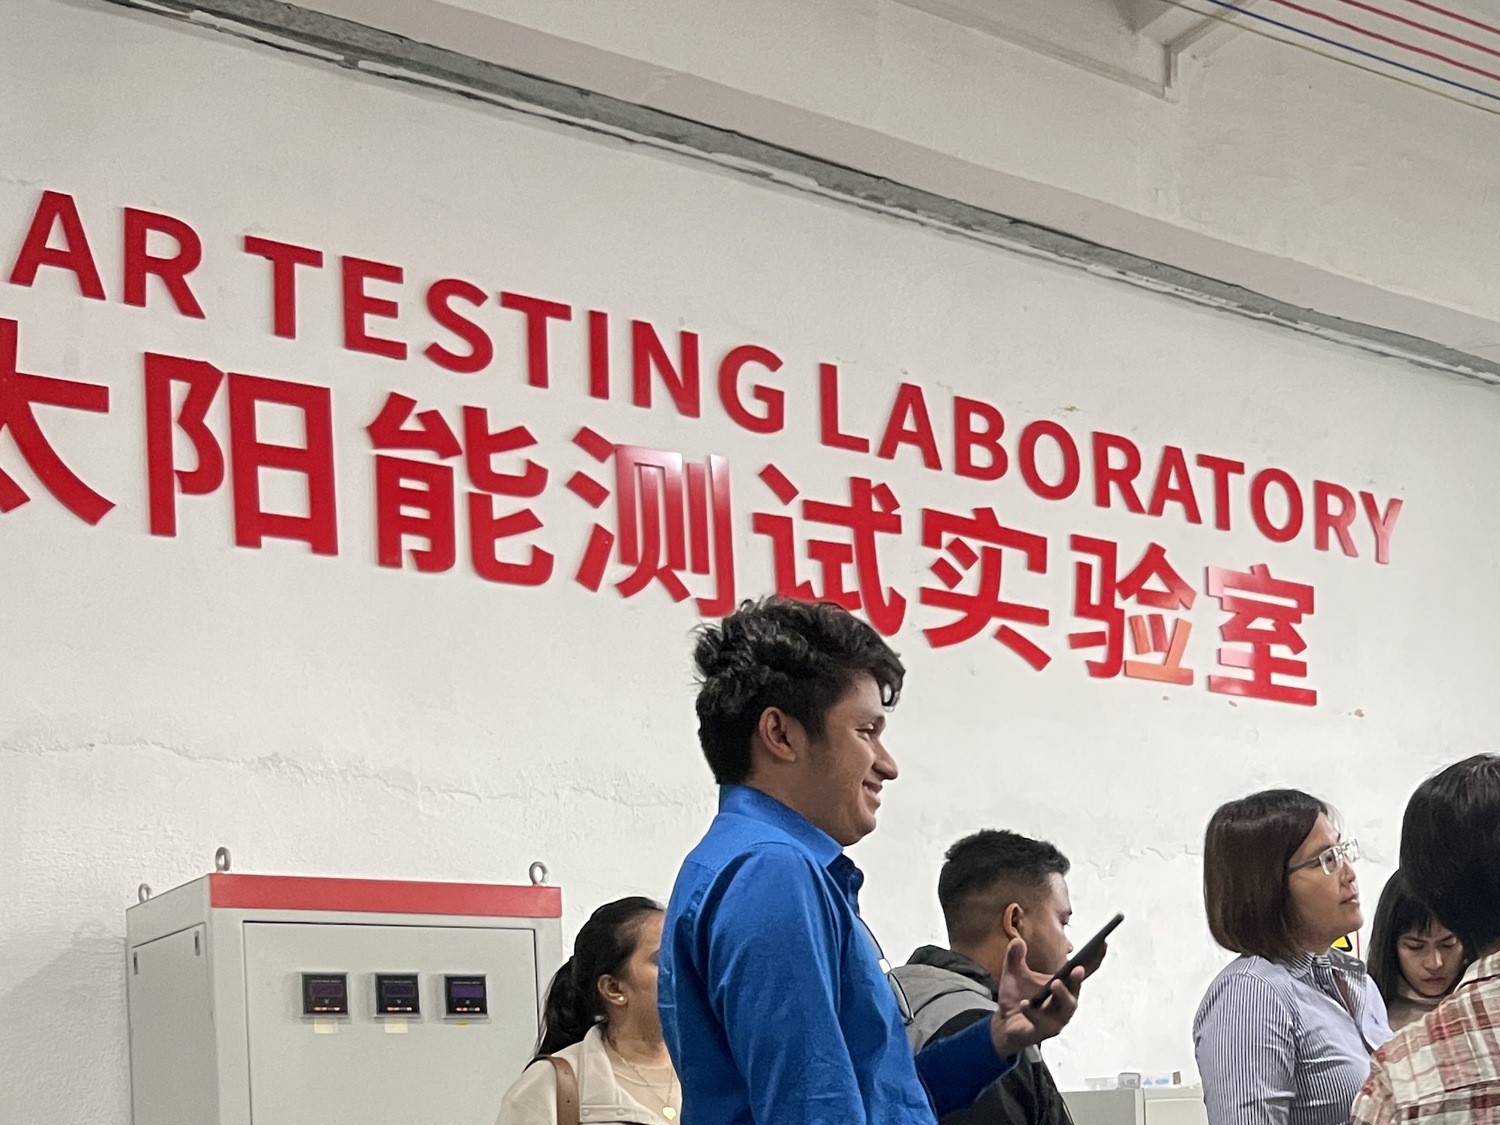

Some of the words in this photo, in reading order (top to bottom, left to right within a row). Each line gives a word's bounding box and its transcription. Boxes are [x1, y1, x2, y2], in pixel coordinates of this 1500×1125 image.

[0, 316, 1318, 707] 太阳能测试实验室
[243, 234, 786, 435] TESTING
[818, 362, 1404, 564] LABORATORY
